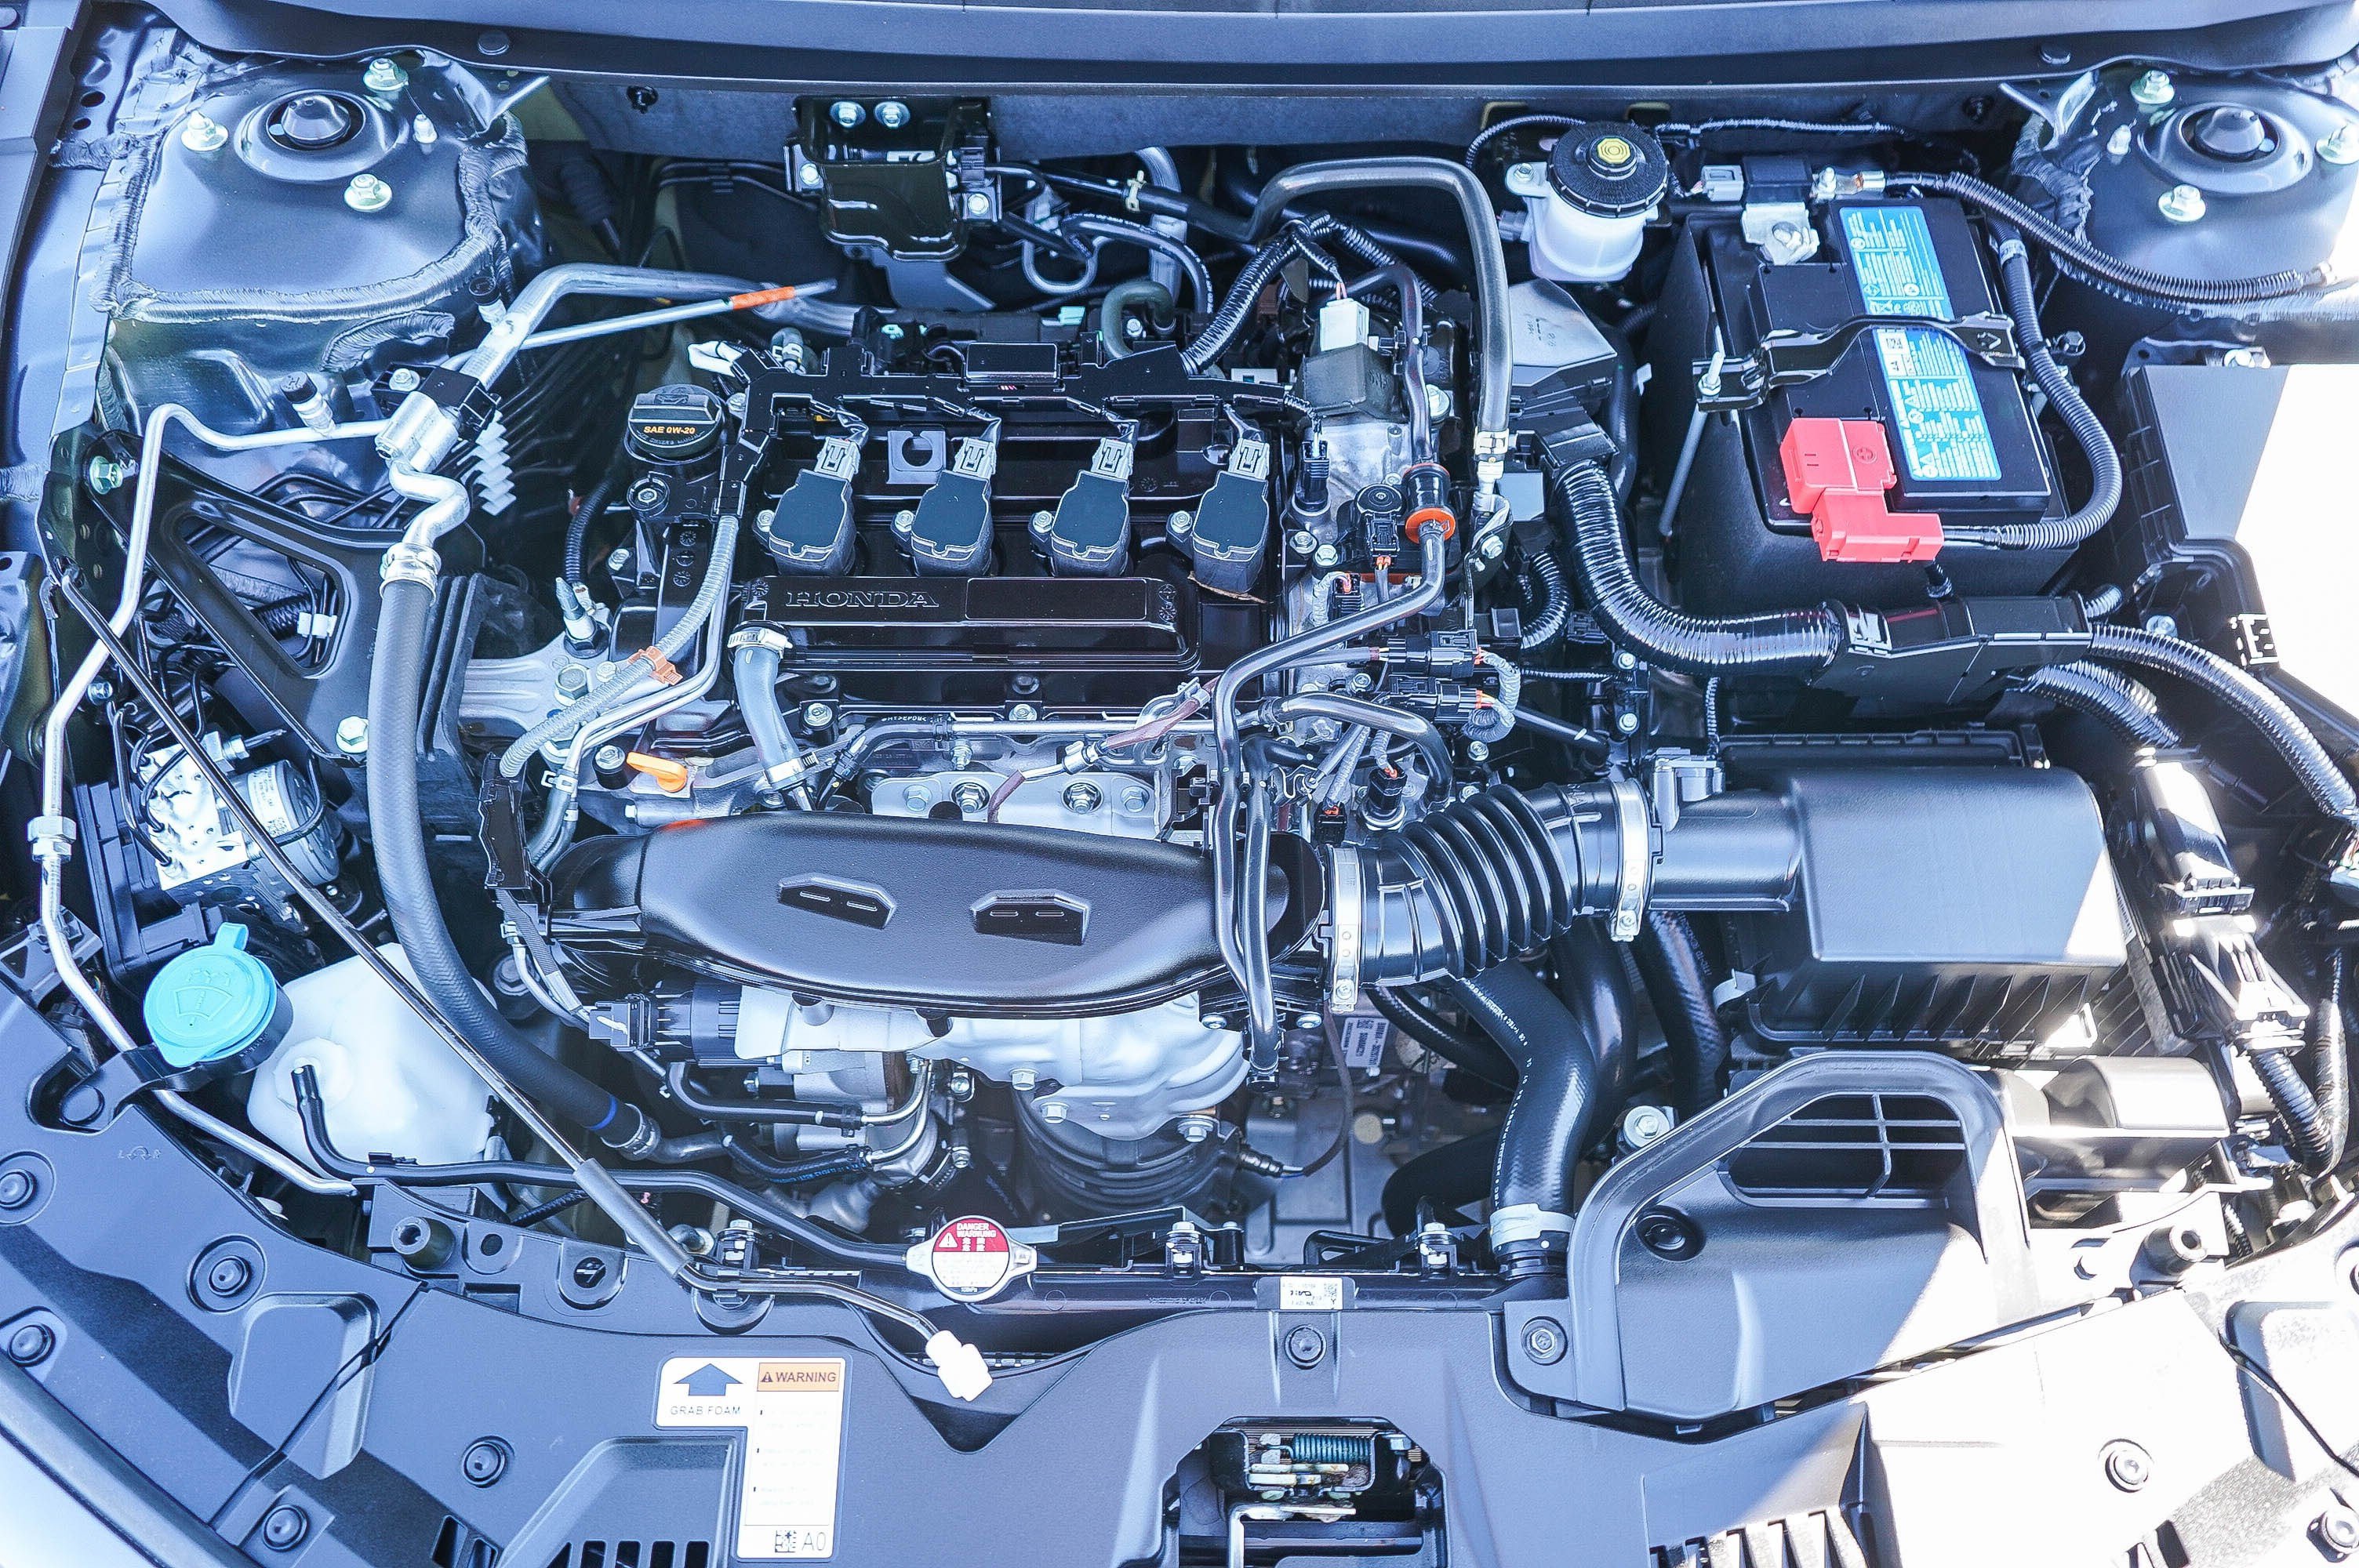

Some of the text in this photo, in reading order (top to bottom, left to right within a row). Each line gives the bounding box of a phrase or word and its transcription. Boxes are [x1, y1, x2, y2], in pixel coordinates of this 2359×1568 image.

[785, 590, 940, 608] HONDA
[956, 1222, 990, 1231] DANGER
[775, 1371, 837, 1383] WARNING
[670, 1406, 740, 1416] GRAB FOAM
